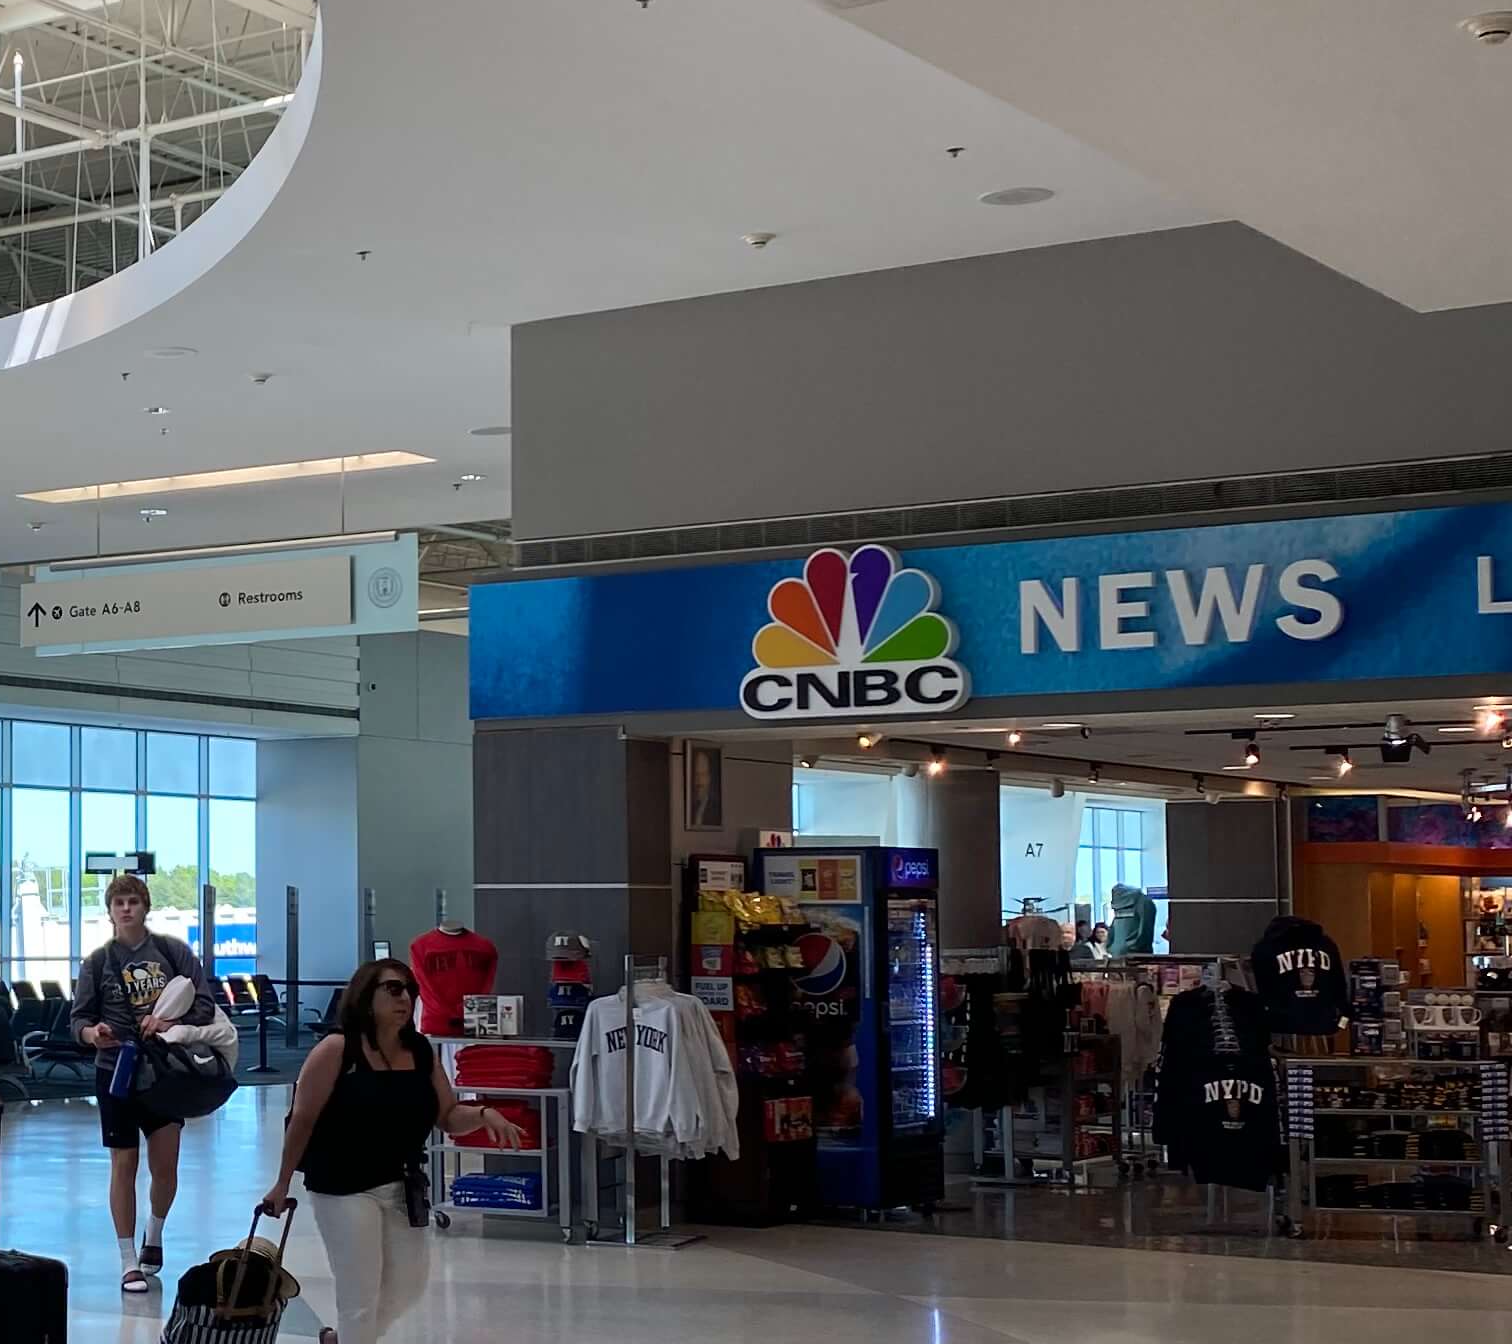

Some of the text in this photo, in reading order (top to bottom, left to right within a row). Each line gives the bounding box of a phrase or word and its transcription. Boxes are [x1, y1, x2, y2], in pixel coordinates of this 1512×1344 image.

[238, 588, 303, 605] Restrooms
[69, 600, 141, 619] Gate A6-A8
[1019, 559, 1344, 655] NEWS
[743, 665, 959, 712] CNBC
[1024, 842, 1044, 858] A7
[904, 859, 929, 879] pepsi
[1276, 948, 1331, 974] NYPD
[133, 976, 166, 993] YEARS
[702, 997, 729, 1006] OARD
[605, 1024, 668, 1054] NE YORK
[1203, 1079, 1264, 1104] NYPD
